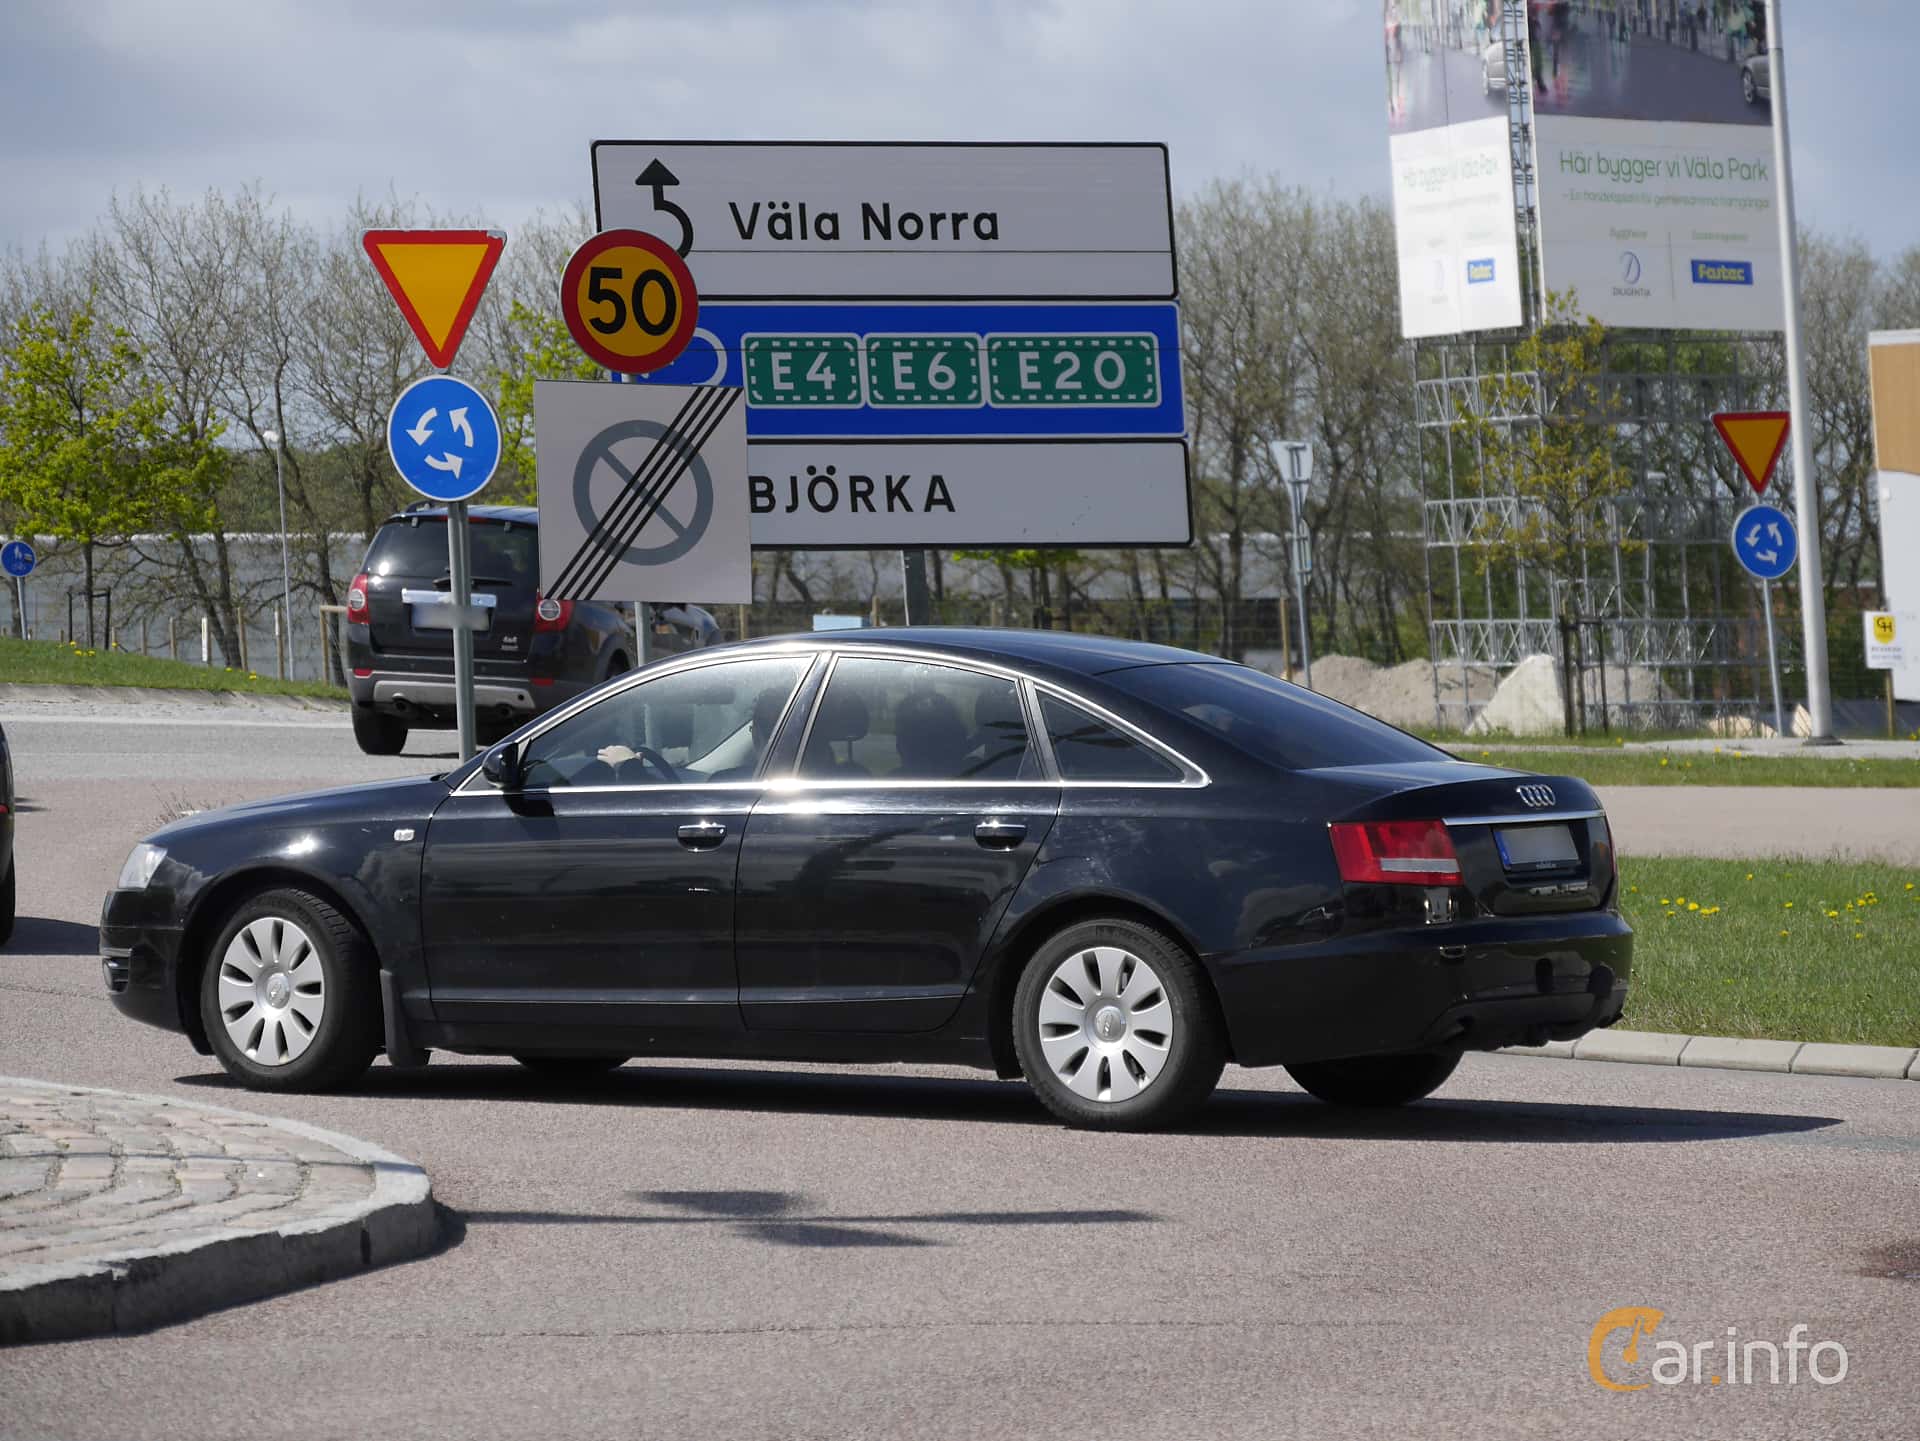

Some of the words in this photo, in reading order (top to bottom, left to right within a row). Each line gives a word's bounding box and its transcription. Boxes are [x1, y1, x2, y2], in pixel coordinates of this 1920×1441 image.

[1559, 151, 1592, 175] Här
[1597, 152, 1662, 184] bygger
[1665, 156, 1680, 178] vi
[1683, 156, 1724, 180] Väla
[1727, 157, 1769, 181] Park
[729, 202, 840, 241] Väla
[862, 203, 999, 241] Norra
[588, 266, 677, 337] 50
[771, 351, 836, 390] E4
[892, 351, 956, 390] E6
[1019, 351, 1126, 390] E20
[748, 465, 956, 514] BJÖRKA
